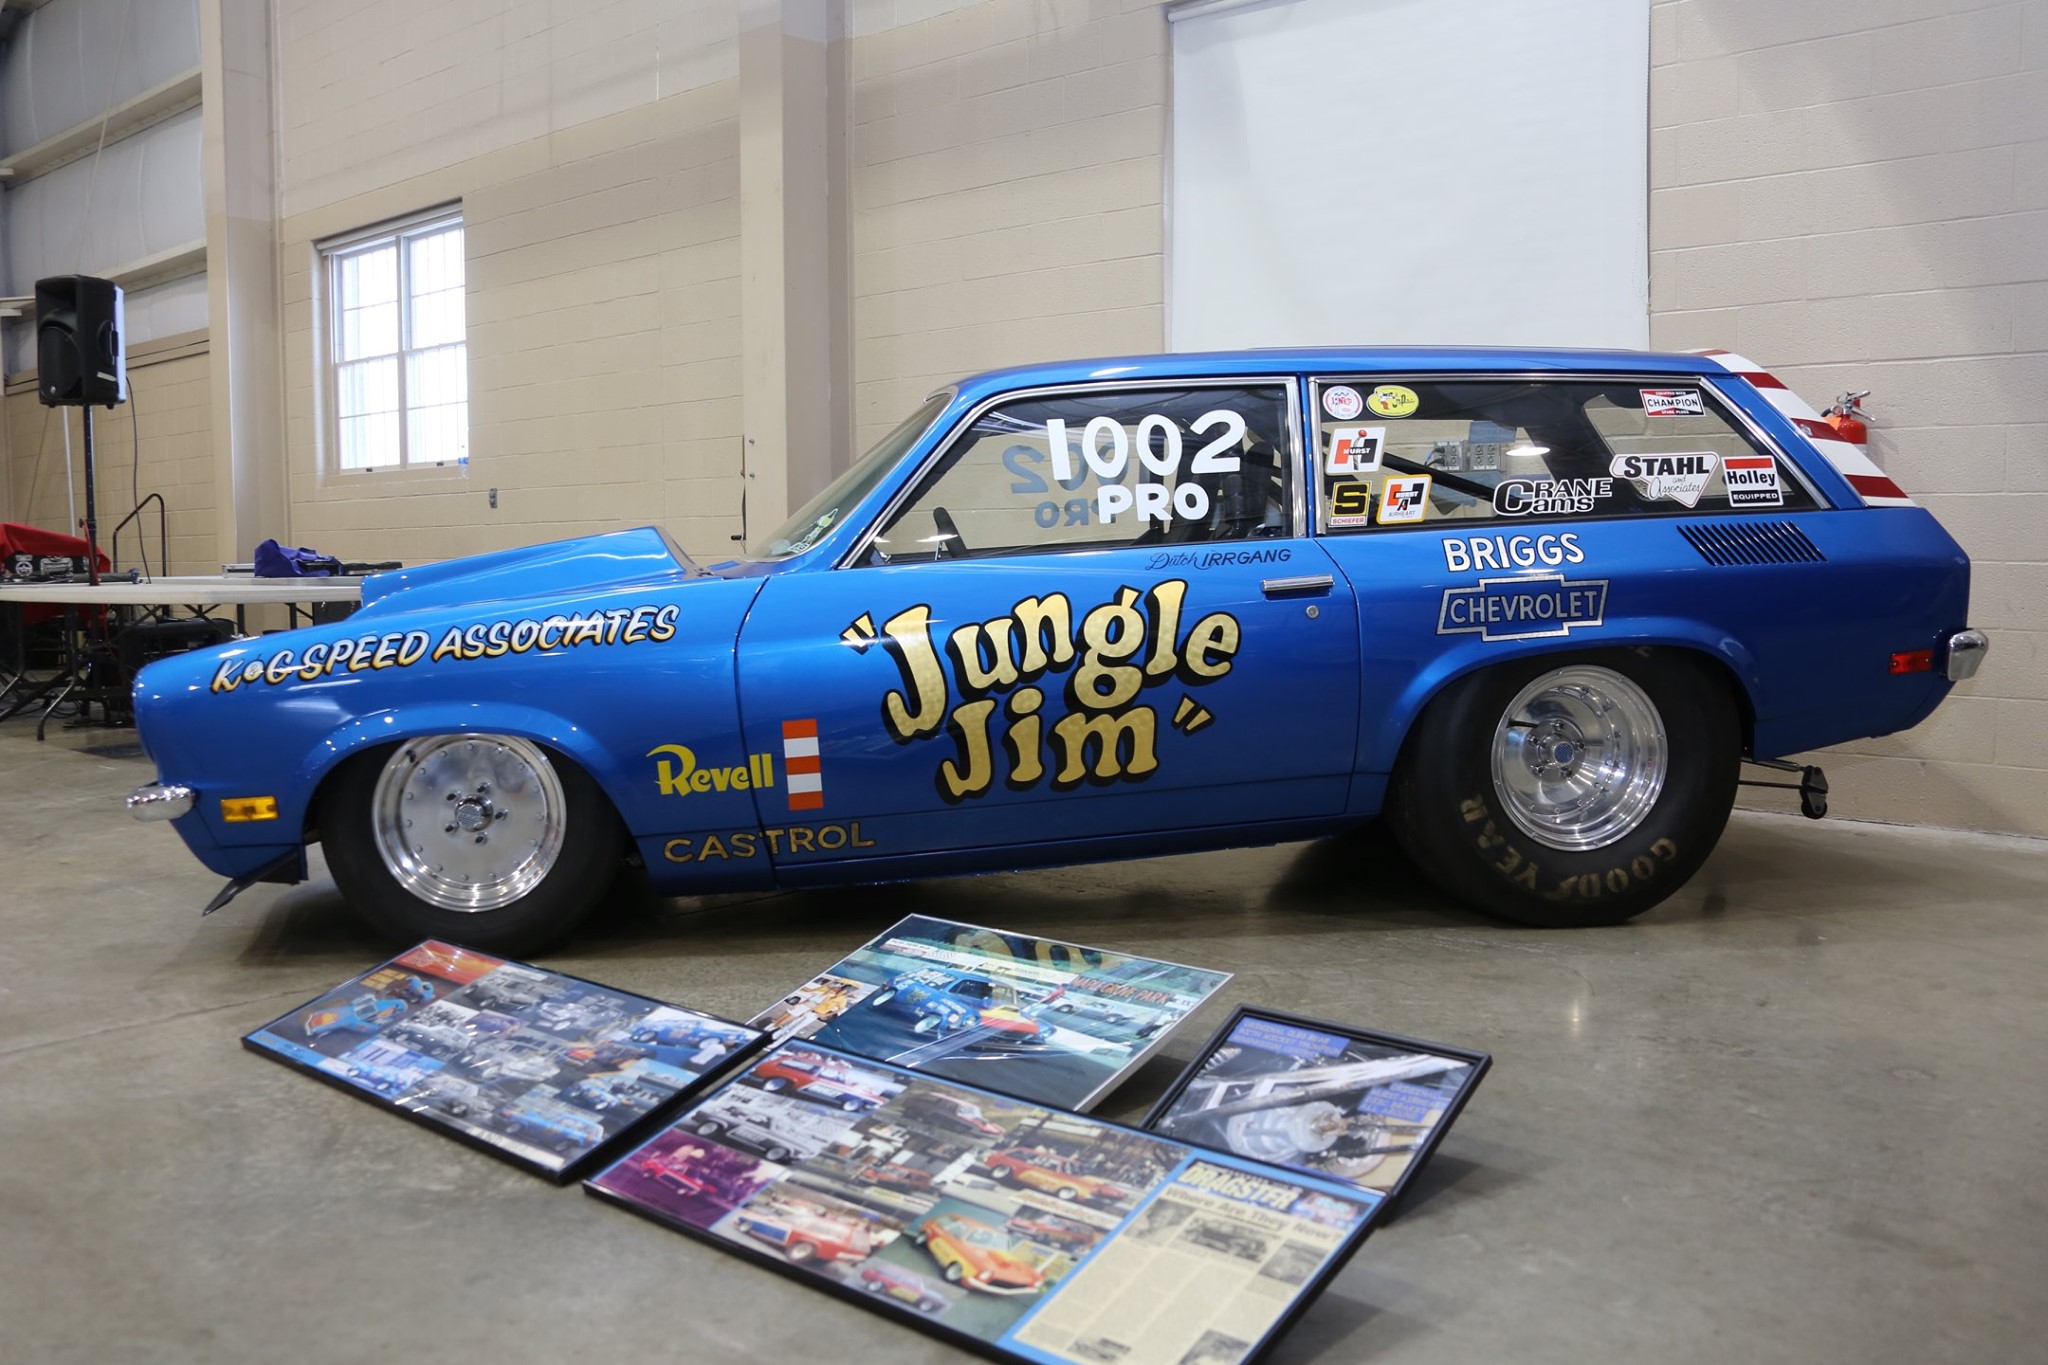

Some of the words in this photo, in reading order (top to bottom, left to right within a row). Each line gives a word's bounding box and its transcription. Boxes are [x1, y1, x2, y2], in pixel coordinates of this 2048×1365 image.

[1647, 398, 1698, 407] CHAMPION
[1046, 409, 1246, 481] 1002
[1343, 447, 1370, 455] HURST
[1623, 455, 1709, 478] STAHL
[1673, 475, 1686, 483] and
[1726, 470, 1775, 487] Holley
[1097, 482, 1209, 523] PRO
[1649, 477, 1700, 499] Associates
[1332, 517, 1364, 525] SCHIEFER
[1145, 551, 1203, 570] Dutch
[1202, 549, 1291, 567] IRRGANG
[1442, 533, 1585, 572] BRIGGS
[1450, 590, 1598, 624] CHEVROLET
[298, 629, 430, 681] SPEED
[432, 604, 681, 663] ASSOCIATES
[646, 744, 774, 797] Revell
[664, 822, 876, 864] CASTROL
[1577, 837, 1677, 898] GOOD
[1165, 1186, 1214, 1208] Where
[1217, 1200, 1247, 1216] Are
[1250, 1208, 1289, 1231] They
